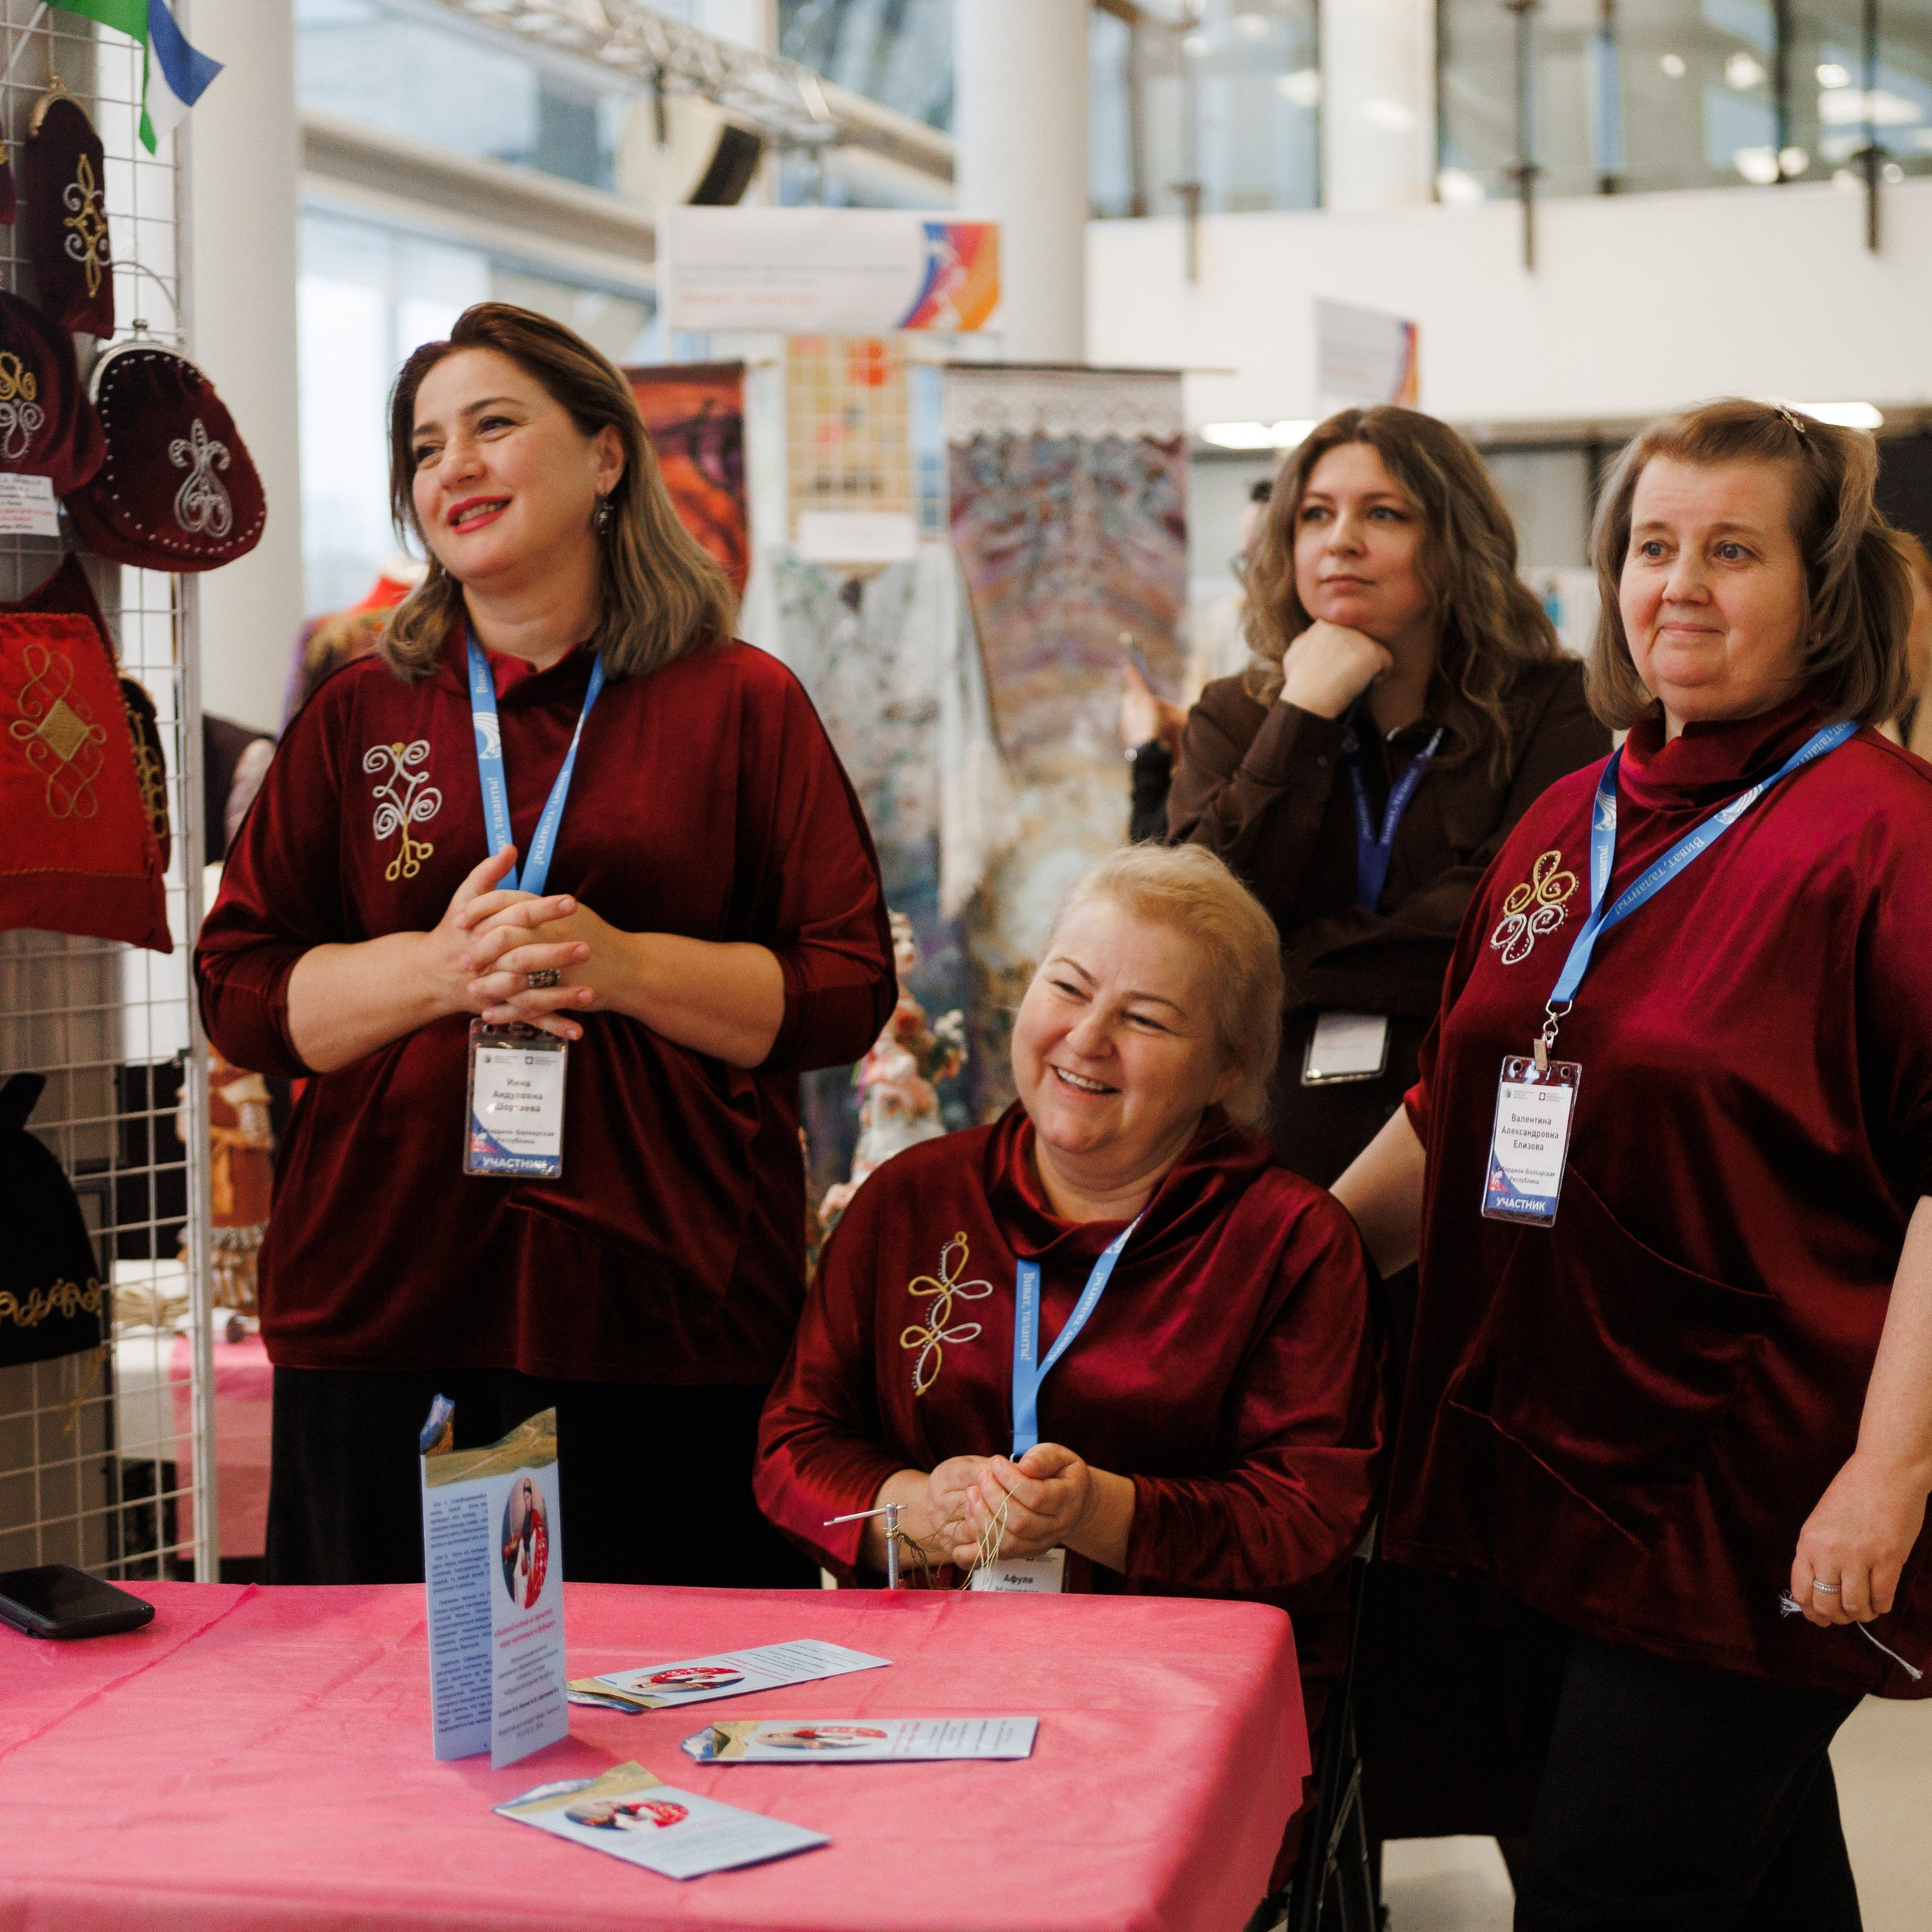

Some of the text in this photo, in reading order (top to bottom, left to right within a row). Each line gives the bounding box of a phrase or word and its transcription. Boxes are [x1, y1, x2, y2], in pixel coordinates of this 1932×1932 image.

[487, 777, 504, 829] таланты!
[1615, 835, 1706, 916] Виват, таланты!
[506, 1078, 531, 1088] Инна
[1511, 1113, 1552, 1126] Валентина
[1500, 1125, 1560, 1140] Александровна
[1513, 1140, 1545, 1152] Елизова
[1509, 1175, 1540, 1186] Республика
[1495, 1196, 1546, 1211] УЧАСТНИК
[1072, 1272, 1105, 1326] таланты!
[1020, 1272, 1035, 1361] Виват, таланты!
